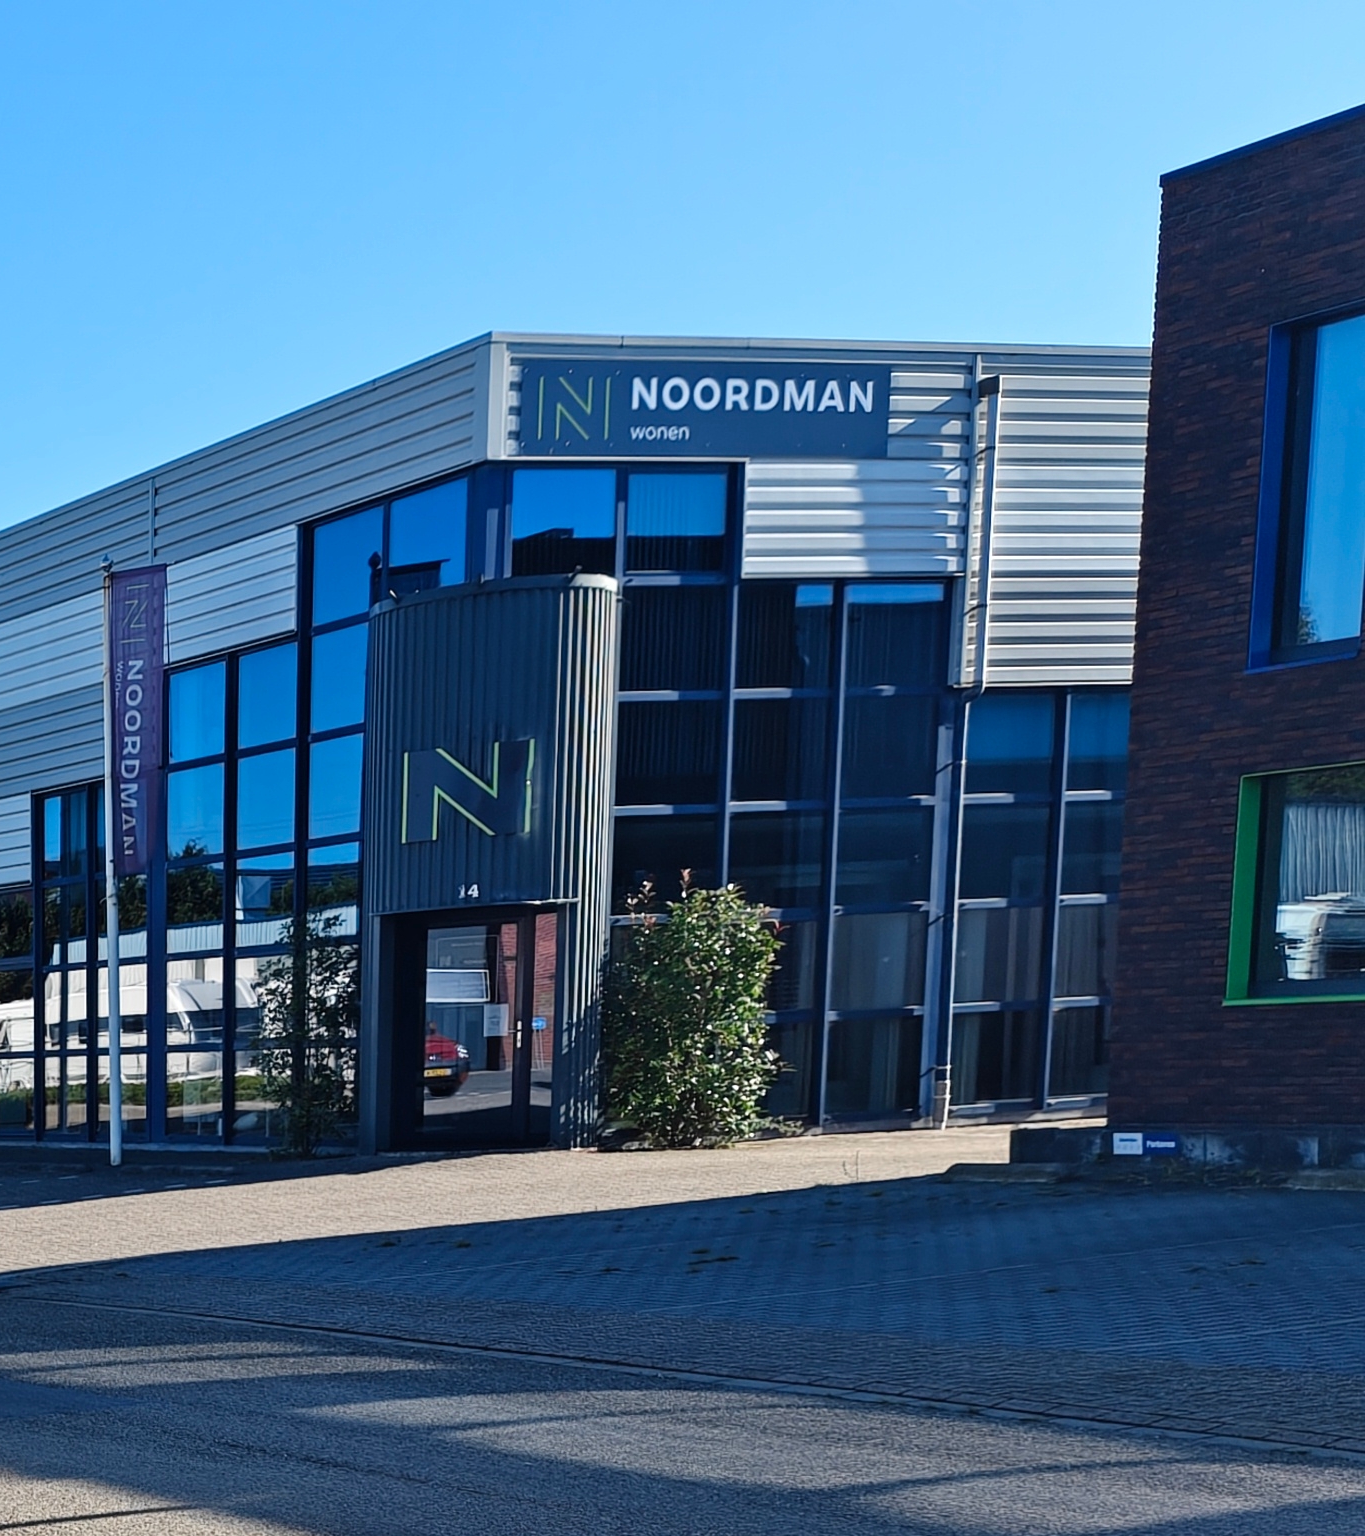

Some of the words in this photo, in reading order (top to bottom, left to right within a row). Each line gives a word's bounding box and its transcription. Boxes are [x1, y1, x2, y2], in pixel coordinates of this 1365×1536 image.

[631, 376, 874, 413] NOORDMAN
[629, 425, 690, 441] wonen
[115, 661, 124, 708] won
[120, 659, 144, 855] NOORDMAN
[458, 884, 479, 898] 14
